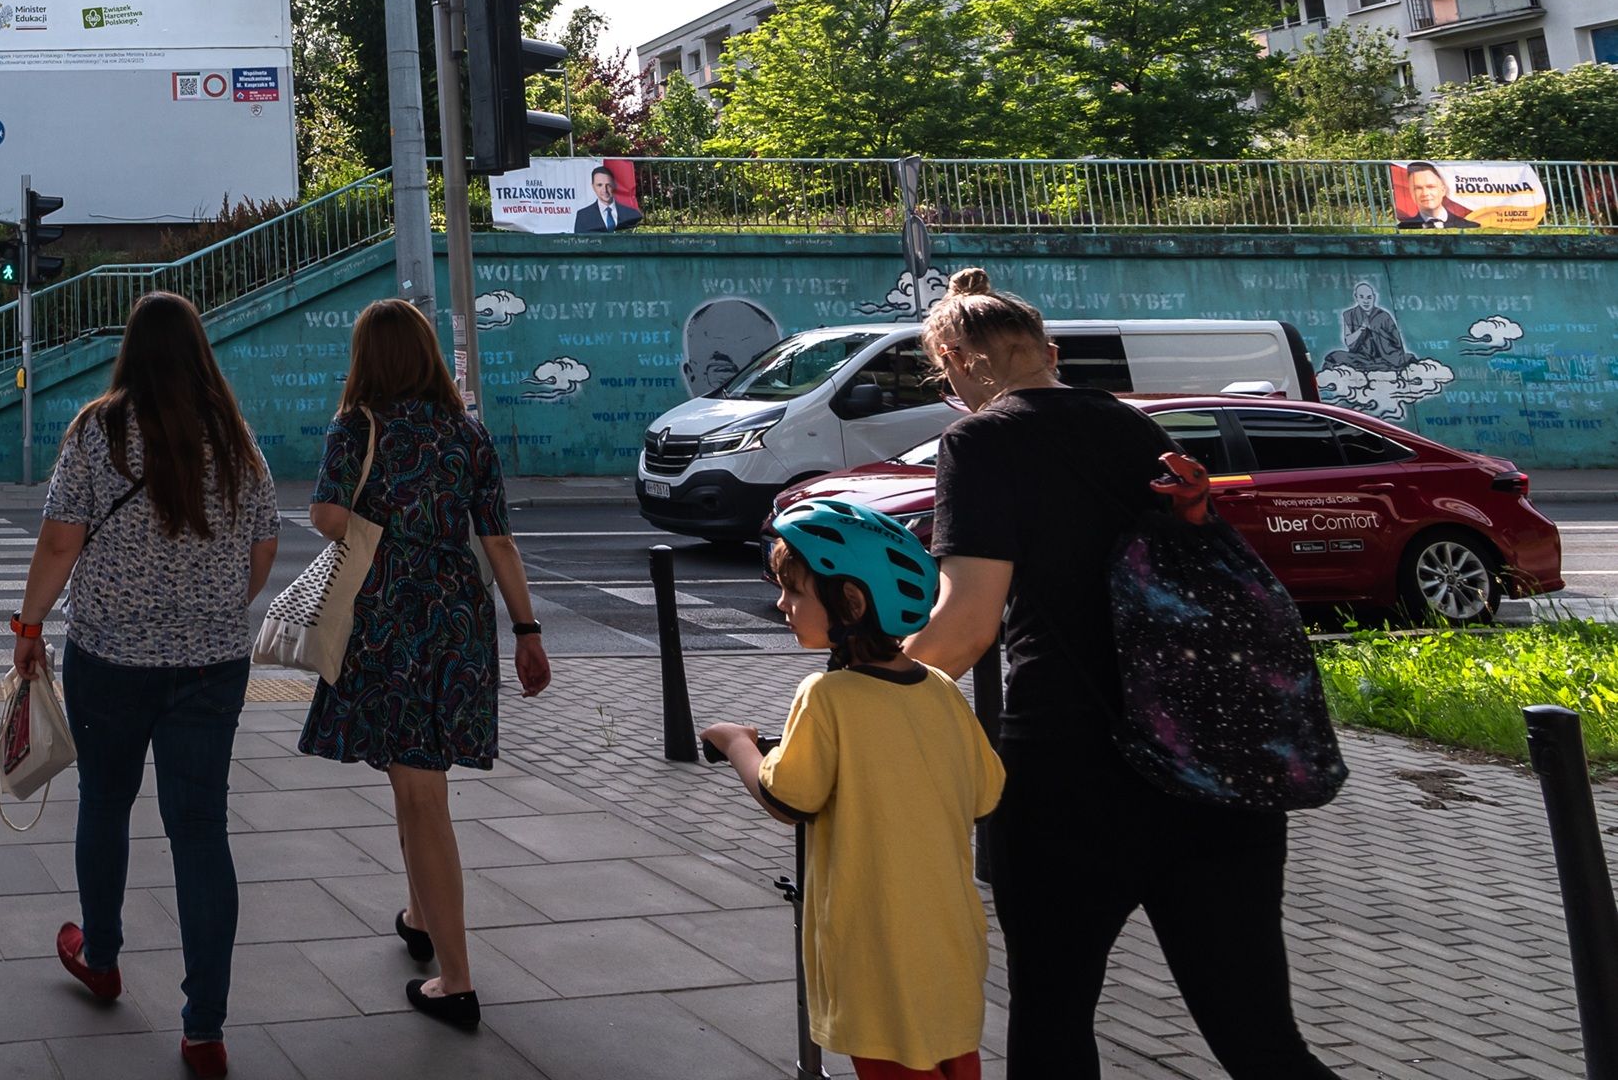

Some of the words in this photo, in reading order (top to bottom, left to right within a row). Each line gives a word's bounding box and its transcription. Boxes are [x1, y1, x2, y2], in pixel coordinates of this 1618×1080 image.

[15, 5, 47, 14] Minister
[103, 4, 132, 15] Związek
[104, 9, 143, 20] Harcerstwa
[15, 14, 48, 24] Edukacji
[105, 17, 138, 27] Polskiego
[1454, 175, 1489, 184] Szymon
[496, 187, 576, 200] TRZASKOWSKI
[1455, 182, 1533, 195] HOŁOWNIA
[503, 205, 528, 215] WYGRA
[544, 205, 572, 215] POLSKA!
[477, 264, 550, 281] WOLNY
[558, 264, 625, 281] TYBET
[1023, 264, 1090, 281] TYBET
[1459, 263, 1526, 280] WOLNY
[1535, 263, 1602, 280] TYBET
[702, 277, 775, 295] WOLNY
[783, 277, 849, 295] TYBET
[1040, 292, 1110, 310] WOLNY
[1118, 292, 1186, 311] TYBET
[1394, 295, 1461, 312] WOLNY
[1467, 294, 1534, 312] TYBET
[527, 301, 597, 320] WOLNY
[606, 300, 673, 318] TYBET
[558, 332, 614, 346] WOLNY
[621, 330, 671, 345] TYBET
[1416, 339, 1450, 350] TYBET
[233, 344, 289, 359] WOLNY
[271, 372, 327, 387] WOLNY
[600, 377, 637, 387] WOLNY
[641, 377, 677, 387] TYBET
[1445, 391, 1499, 404] WOLNY
[1504, 390, 1556, 404] TYBET
[592, 411, 630, 421] WOLNY
[1425, 416, 1463, 426] WOLNY
[1466, 415, 1501, 425] TYBET
[1529, 419, 1566, 429] WOLNY
[1570, 419, 1604, 429] TYBET
[1273, 498, 1298, 508] Więcej
[1298, 498, 1325, 507] wygody
[1326, 496, 1337, 505] dla
[1266, 516, 1309, 533] Uber
[1311, 512, 1380, 531] Comfort
